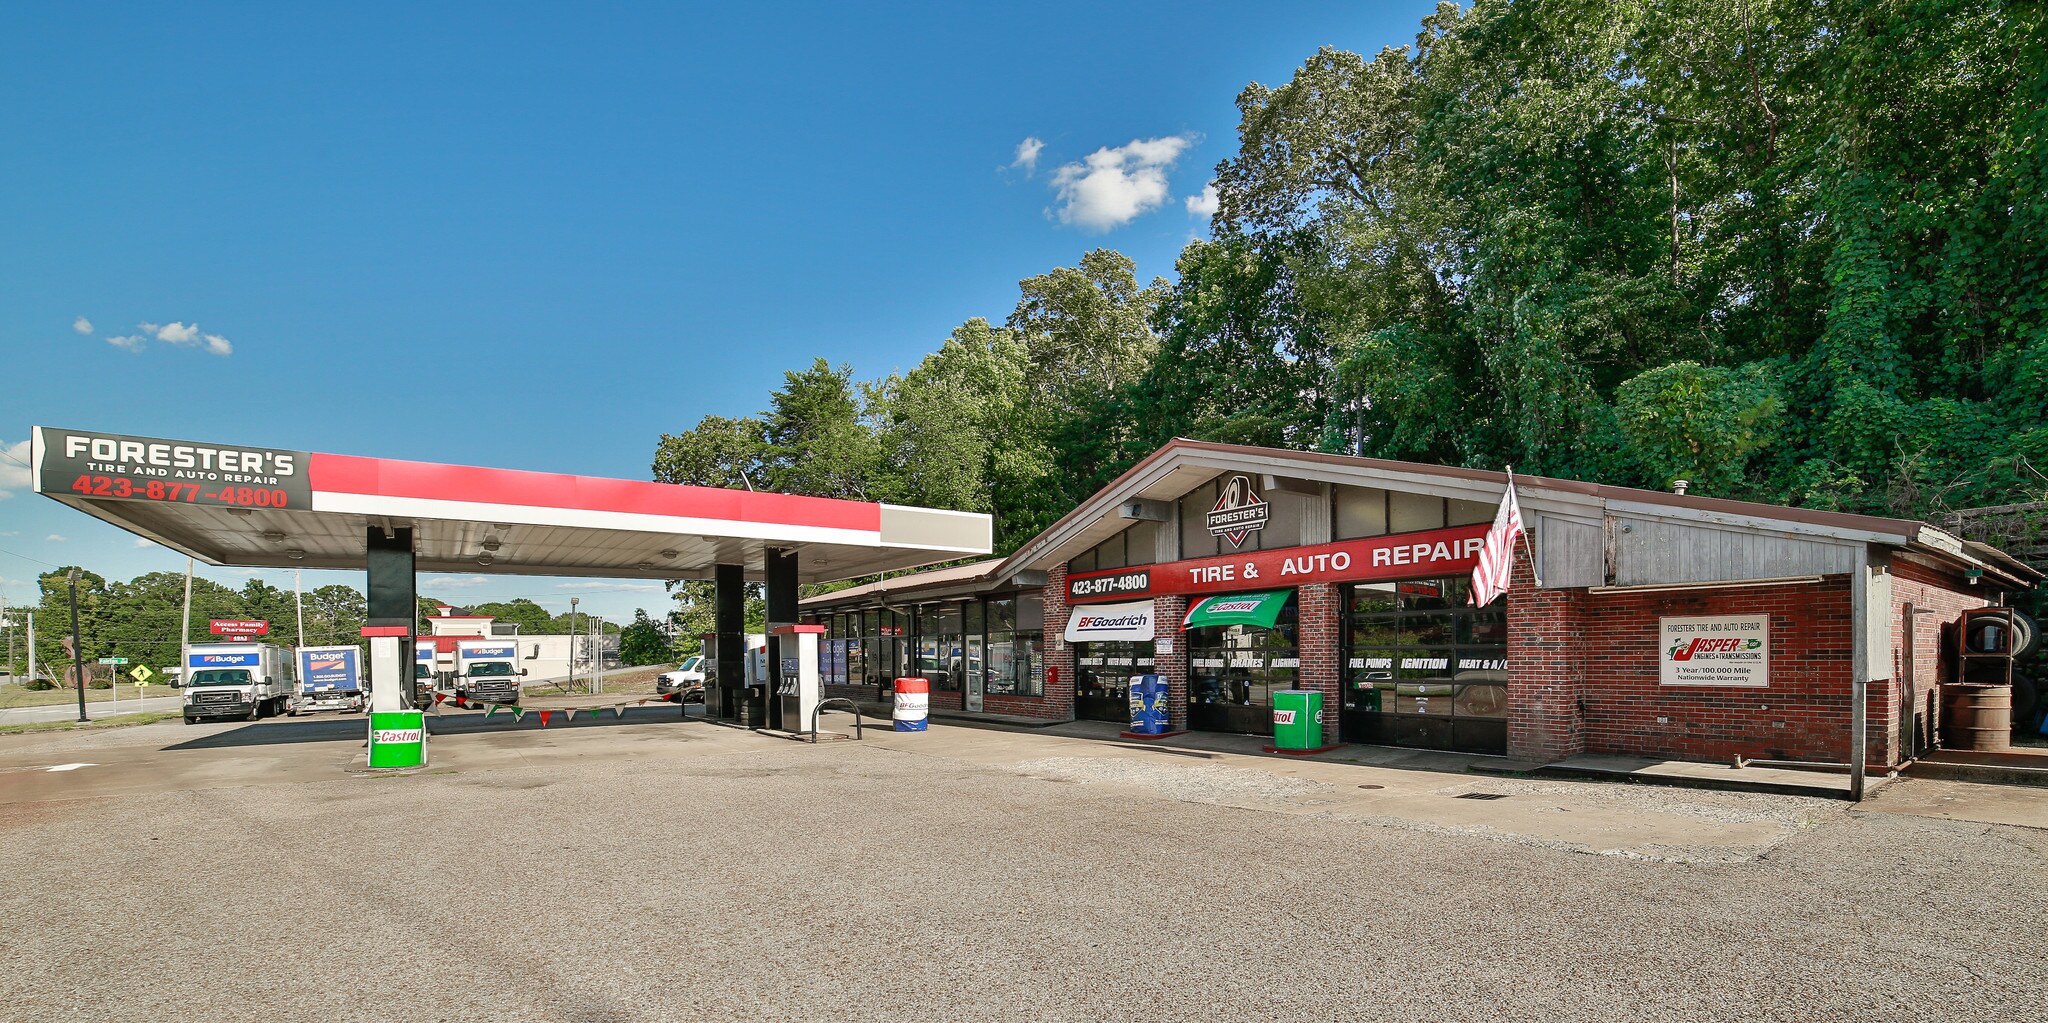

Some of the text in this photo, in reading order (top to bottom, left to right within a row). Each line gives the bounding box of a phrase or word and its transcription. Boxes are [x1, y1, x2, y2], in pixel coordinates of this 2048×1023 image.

[66, 436, 294, 476] FORESTER'S
[87, 462, 278, 485] TIRE AND AUTO REPAIR
[72, 475, 288, 508] 423-877-4800
[1210, 508, 1264, 524] FORESTER'S
[1190, 538, 1484, 584] TIRE & AUTO REPAIR
[1072, 574, 1147, 595] 423-877-4800
[1216, 602, 1256, 610] Castrol
[1078, 614, 1147, 628] BFGoodrich
[1668, 624, 1695, 632] FORESTERS
[1673, 638, 1741, 661] JASPER
[216, 655, 245, 664] Budget
[310, 652, 345, 661] Budget
[1230, 658, 1264, 668] BRAKES
[1271, 658, 1300, 668] ALIGNMEN
[1349, 658, 1392, 668] FUEL PUMPS
[1401, 658, 1448, 669] IGNITION
[1459, 659, 1481, 669] HEAT
[1482, 659, 1490, 669] &
[382, 731, 419, 742] Castrol
